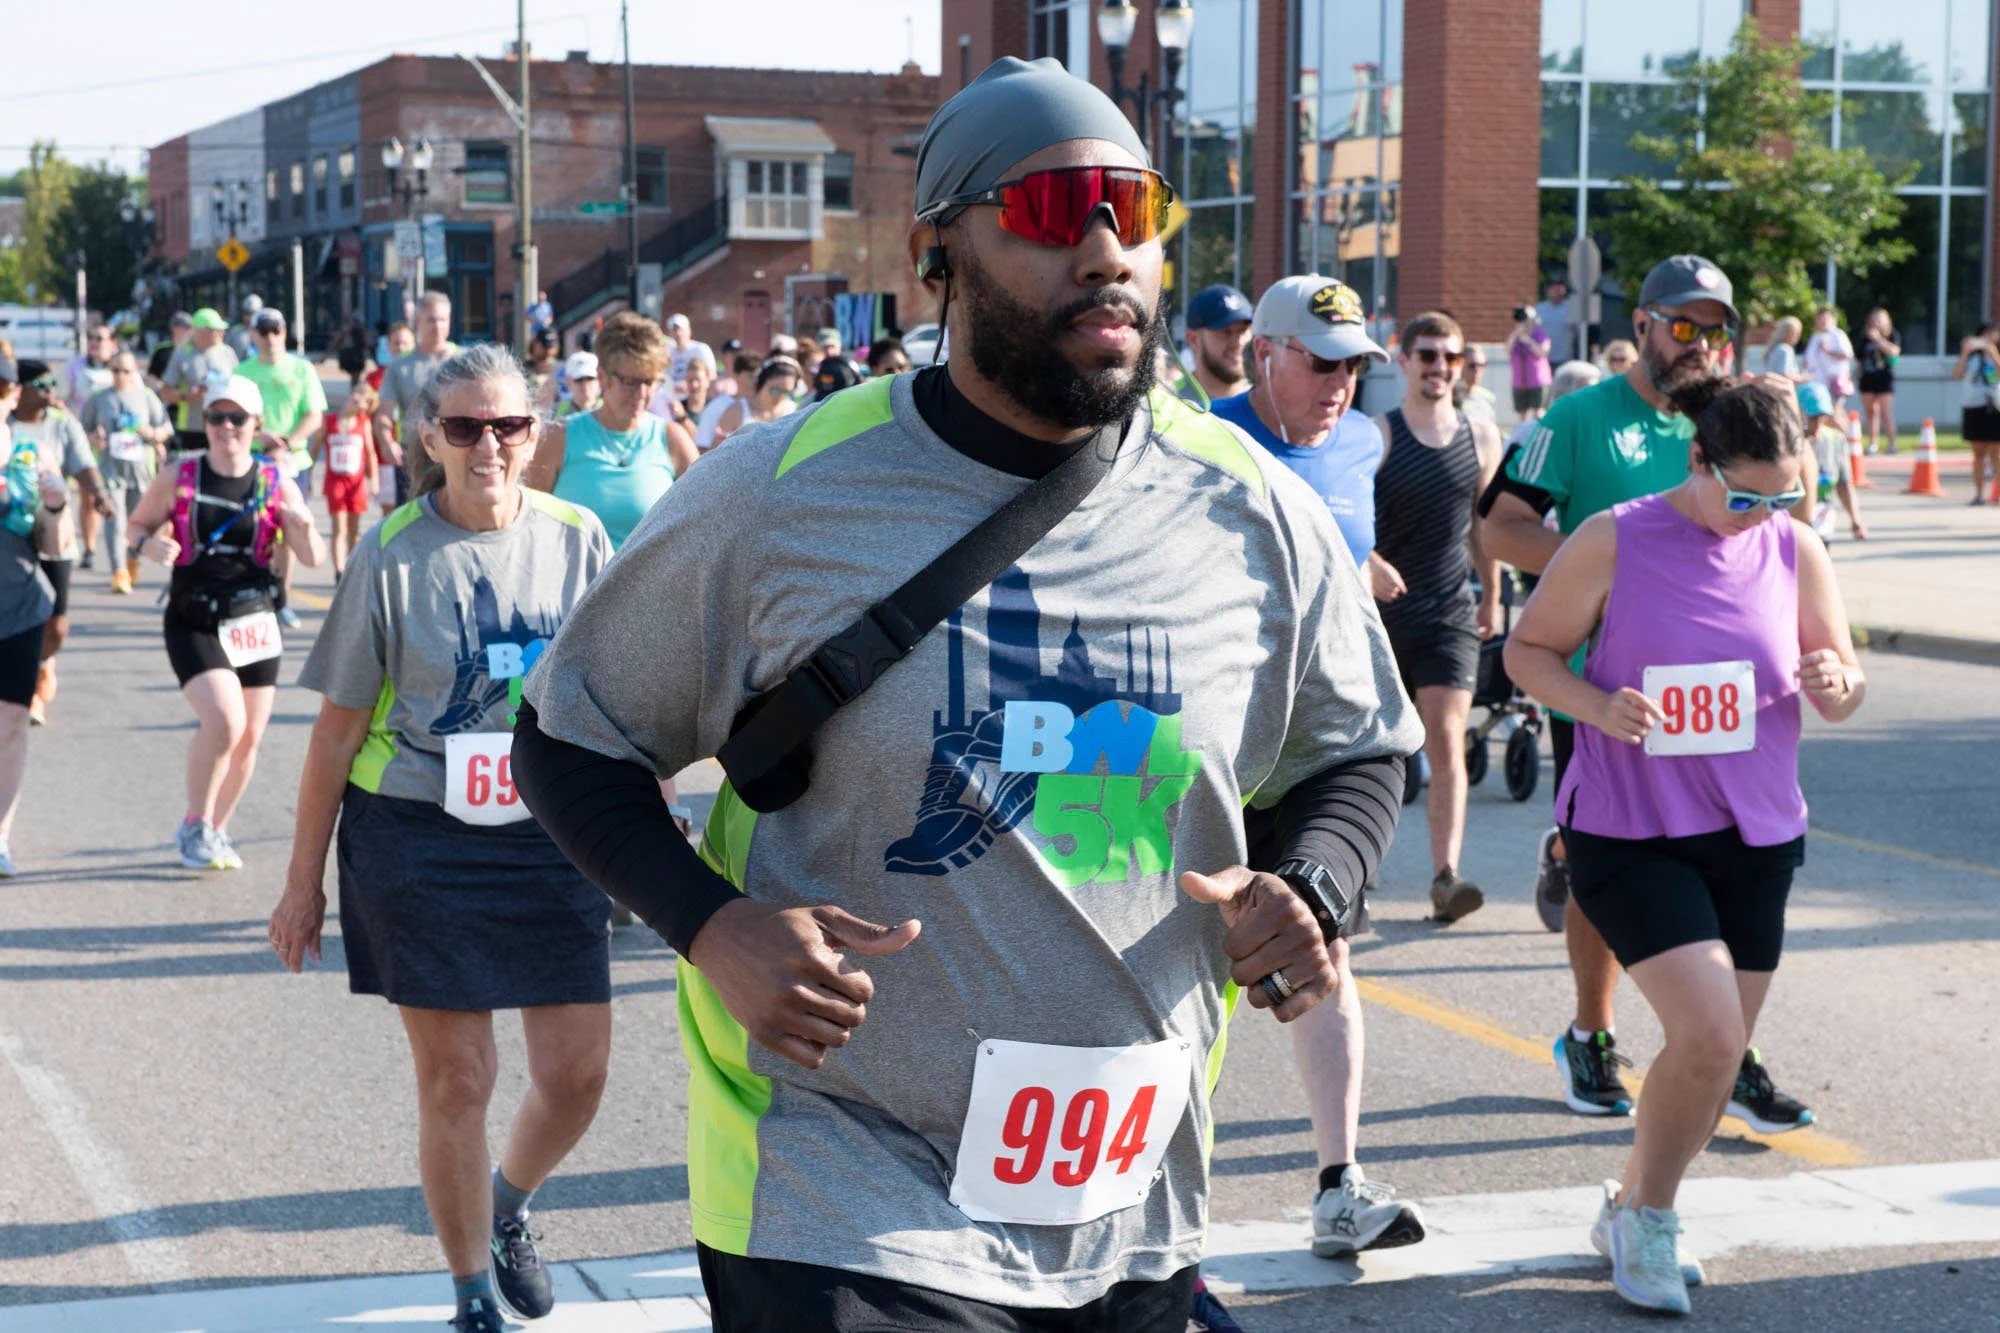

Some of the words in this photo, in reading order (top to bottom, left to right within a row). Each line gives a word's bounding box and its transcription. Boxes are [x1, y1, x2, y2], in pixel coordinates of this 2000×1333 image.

[835, 293, 889, 349] BWL
[1000, 699, 1204, 775] BWL
[1662, 682, 1740, 736] 988
[1033, 775, 1199, 888] 5K
[993, 1085, 1158, 1187] 994
